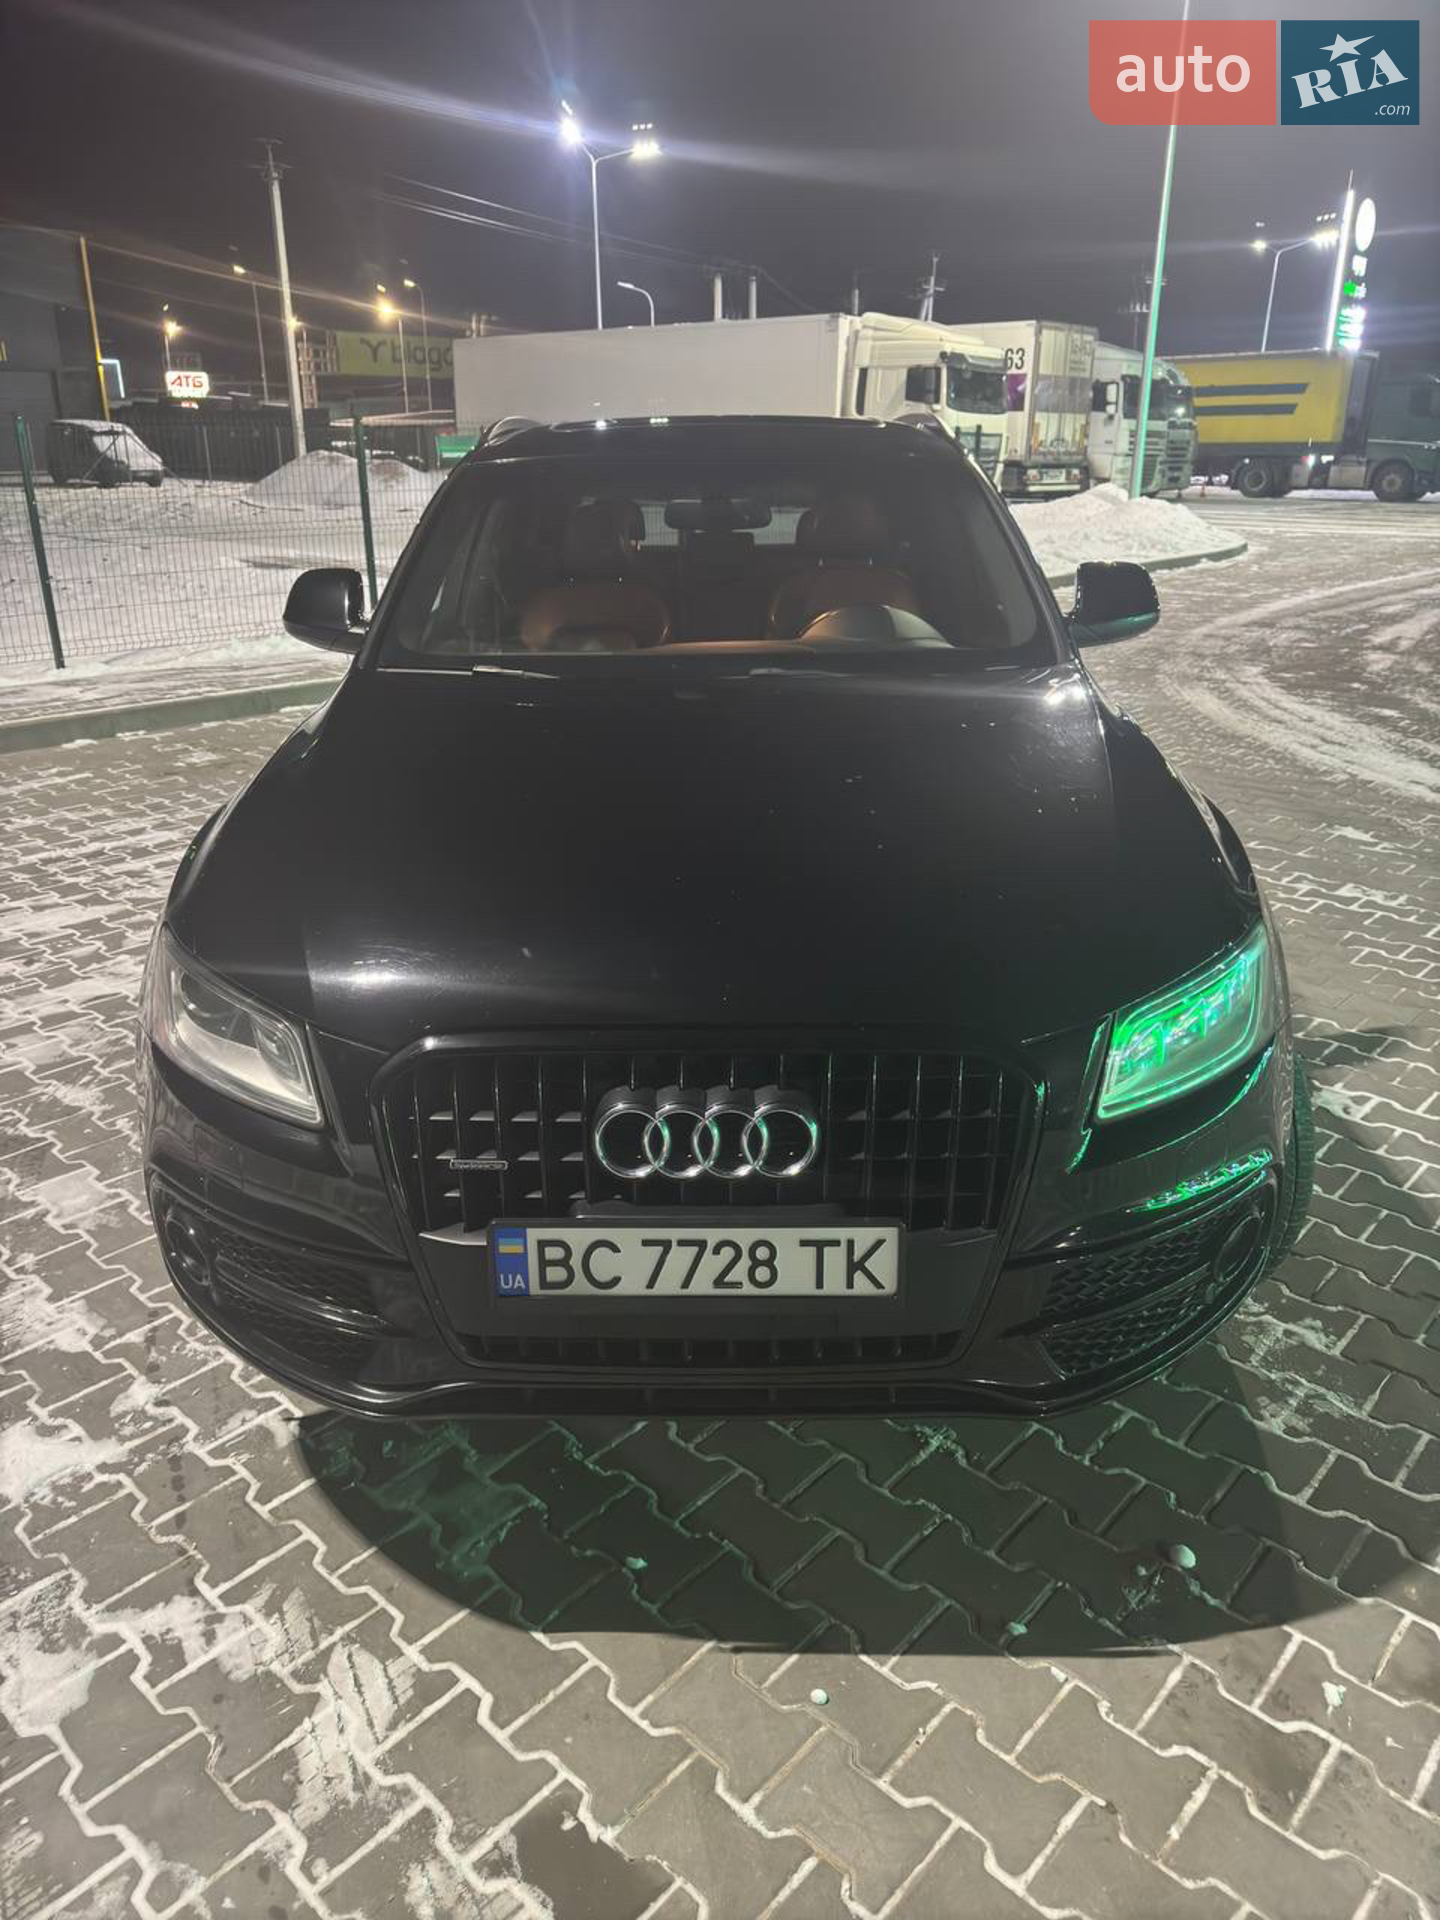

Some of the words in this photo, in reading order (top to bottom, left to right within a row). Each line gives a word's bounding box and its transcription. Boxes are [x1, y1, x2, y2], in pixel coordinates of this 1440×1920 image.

[500, 1273, 526, 1290] UA
[536, 1238, 622, 1291] BC
[641, 1239, 778, 1290] 7728
[799, 1239, 887, 1290] TK
